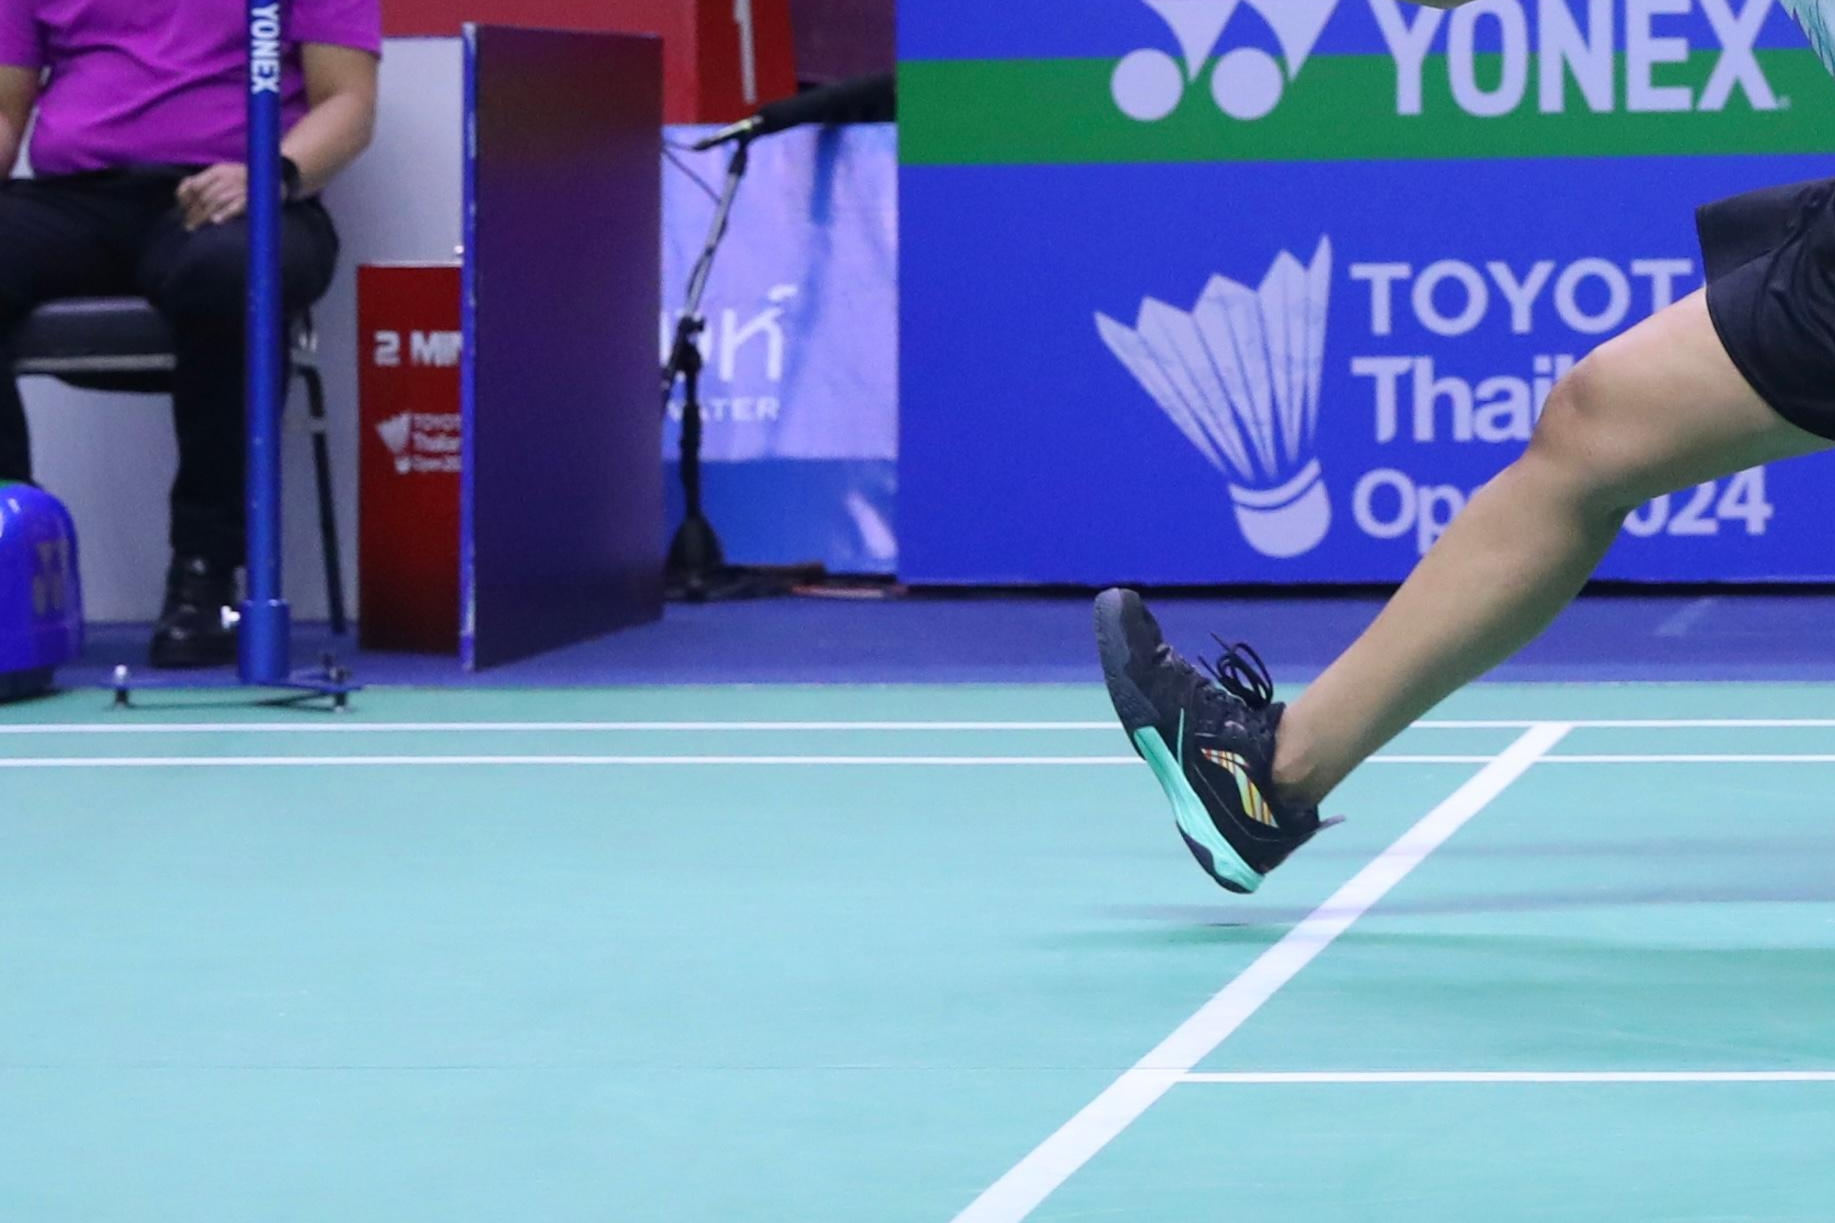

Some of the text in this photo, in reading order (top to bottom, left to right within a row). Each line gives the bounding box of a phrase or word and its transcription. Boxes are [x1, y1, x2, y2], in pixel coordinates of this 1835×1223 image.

[251, 3, 280, 95] YONEX
[1349, 257, 1705, 337] TOYOT
[374, 330, 401, 367] 2
[1350, 355, 1576, 444] Thai
[1353, 467, 1480, 556] Op
